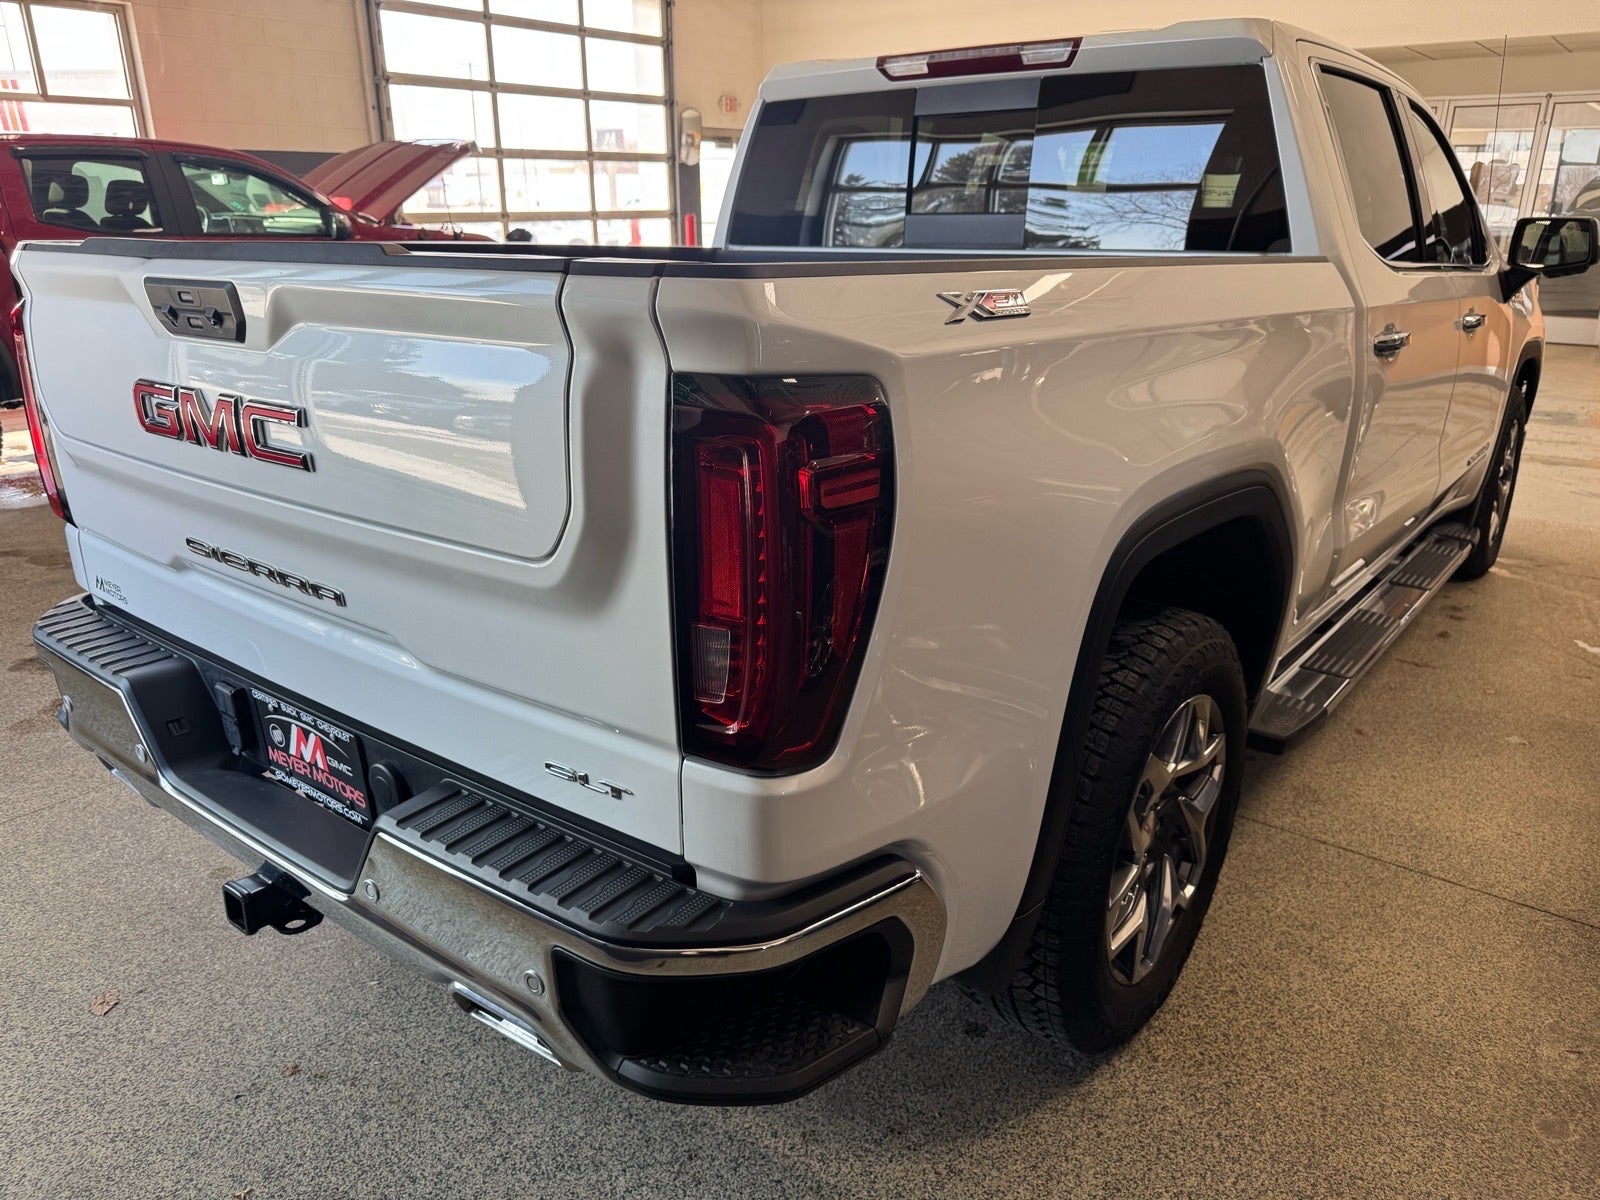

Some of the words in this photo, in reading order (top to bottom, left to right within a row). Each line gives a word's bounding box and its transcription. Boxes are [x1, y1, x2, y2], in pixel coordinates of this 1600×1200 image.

[132, 378, 316, 473] GMC
[185, 537, 347, 607] SIERRA
[280, 703, 299, 718] BUICK
[299, 712, 315, 726] GMC
[267, 746, 312, 778] MEYER
[312, 766, 367, 809] MOTORS
[326, 755, 353, 777] GMC
[544, 759, 634, 800] SLT
[274, 770, 364, 825] GOMEYERMOTORS.COM
